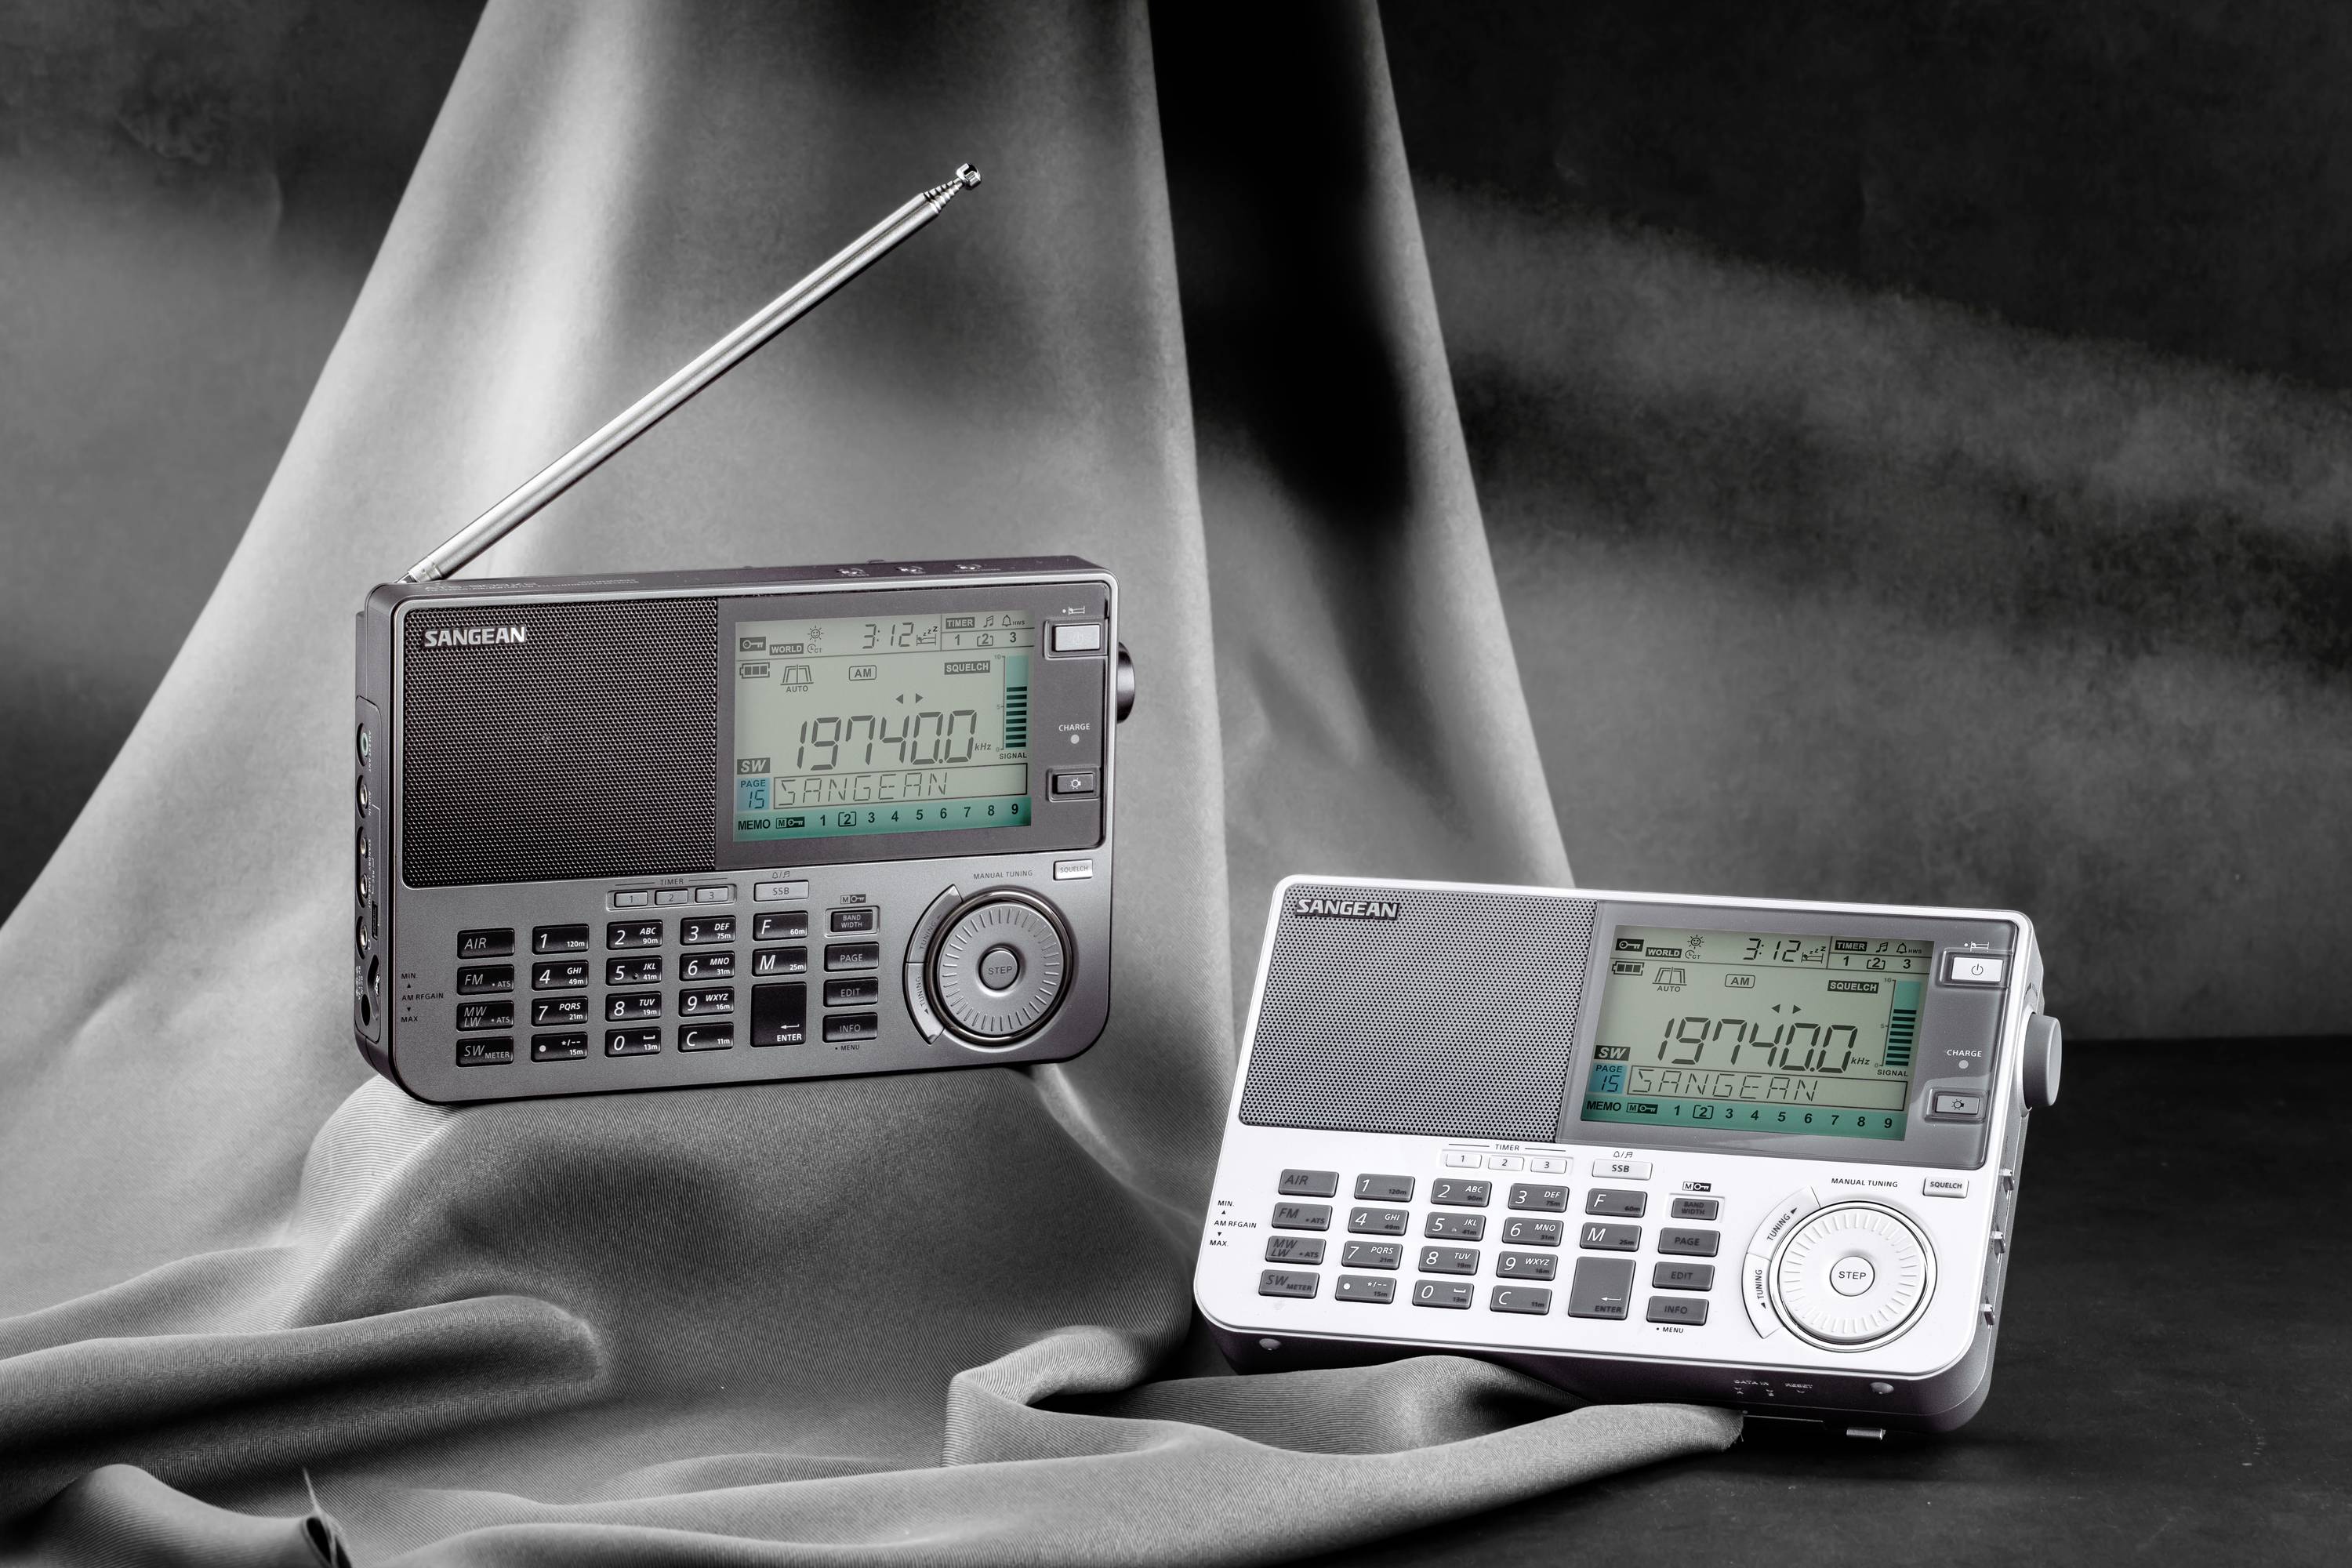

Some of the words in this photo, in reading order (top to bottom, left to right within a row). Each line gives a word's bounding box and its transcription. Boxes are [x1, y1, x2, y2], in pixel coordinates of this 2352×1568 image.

[946, 618, 974, 628] TIMER
[424, 626, 526, 647] SANGEAN
[862, 622, 913, 649] 3:12
[771, 644, 802, 654] WORLD
[854, 668, 872, 678] AM
[946, 662, 989, 673] SQUELCH
[1058, 723, 1091, 731] CHARGE
[797, 710, 977, 771] 19740.0
[740, 759, 767, 773] SW
[779, 771, 947, 806] SANGEAN
[749, 789, 765, 809] 15
[738, 818, 771, 831] MEMO
[819, 815, 826, 826] 1
[844, 814, 851, 824] 2
[868, 811, 875, 822] 3
[891, 811, 898, 822] 4
[916, 809, 924, 820] 5
[940, 808, 947, 818] 6
[964, 807, 971, 818] 7
[987, 805, 995, 815] 8
[1011, 804, 1018, 815] 9
[973, 871, 1004, 880] MANUAL
[1006, 869, 1033, 878] TUNING
[660, 877, 684, 886] TIMER
[772, 887, 790, 895] SSB
[1296, 898, 1399, 917] SANGEAN
[688, 926, 699, 941] 3
[761, 920, 771, 935] F
[540, 933, 548, 949] 1
[615, 930, 626, 945] 2
[920, 921, 937, 949] TUNING
[464, 938, 487, 949] AIR
[1837, 942, 1866, 950] TIMER
[1743, 938, 1802, 963] 3:12
[760, 954, 775, 970] M
[840, 953, 863, 962] PAGE
[615, 965, 626, 980] 5
[688, 960, 699, 975] 6
[988, 966, 1013, 975] STEP
[465, 974, 484, 985] FM
[539, 969, 550, 984] 4
[1730, 977, 1750, 985] AM
[840, 988, 861, 997] EDIT
[916, 976, 924, 1007] TUNING
[1830, 982, 1877, 992] SQUELCH
[614, 1001, 625, 1016] 8
[687, 996, 698, 1011] 9
[706, 993, 728, 1002] WXYZ
[464, 1006, 487, 1017] MW
[539, 1006, 548, 1021] 7
[463, 1017, 481, 1027] LW
[840, 1024, 861, 1033] INFO
[614, 1036, 625, 1051] 0
[686, 1031, 698, 1047] C
[776, 1033, 802, 1042] ENTER
[463, 1045, 485, 1057] SW
[1657, 1017, 1858, 1073] 19740.0
[1851, 1057, 1870, 1065] kHz
[1599, 1047, 1626, 1059] SW
[1947, 1049, 1982, 1058] CHARGE
[1595, 1065, 1623, 1073] PAGE
[1601, 1075, 1620, 1093] 15
[1632, 1069, 1818, 1102] SANGEAN
[1586, 1101, 1621, 1111] MEMO
[1611, 1164, 1629, 1173] SSB
[1284, 1174, 1308, 1185] AIR
[1362, 1179, 1370, 1192] 1
[1437, 1184, 1450, 1198] 2
[1515, 1190, 1527, 1204] 3
[1594, 1194, 1606, 1207] F
[1279, 1208, 1299, 1218] FM
[1355, 1213, 1367, 1225] 4
[1432, 1218, 1446, 1232] 5
[1510, 1222, 1523, 1236] 6
[1534, 1223, 1555, 1232] MNO
[1766, 1213, 1791, 1242] TUNING
[1587, 1228, 1606, 1241] M
[1674, 1236, 1700, 1246] PAGE
[1273, 1239, 1298, 1249] MW
[1271, 1248, 1291, 1257] LW
[1348, 1246, 1359, 1259] 7
[1425, 1250, 1439, 1265] 8
[1504, 1257, 1516, 1270] 9
[1525, 1258, 1550, 1266] WXYZ
[1265, 1274, 1289, 1286] SW
[1671, 1271, 1693, 1280] EDIT
[1838, 1270, 1867, 1280] STEP
[1755, 1269, 1764, 1299] TUNING
[1421, 1285, 1434, 1298] 0
[1498, 1291, 1512, 1305] C
[1664, 1305, 1688, 1315] INFO
